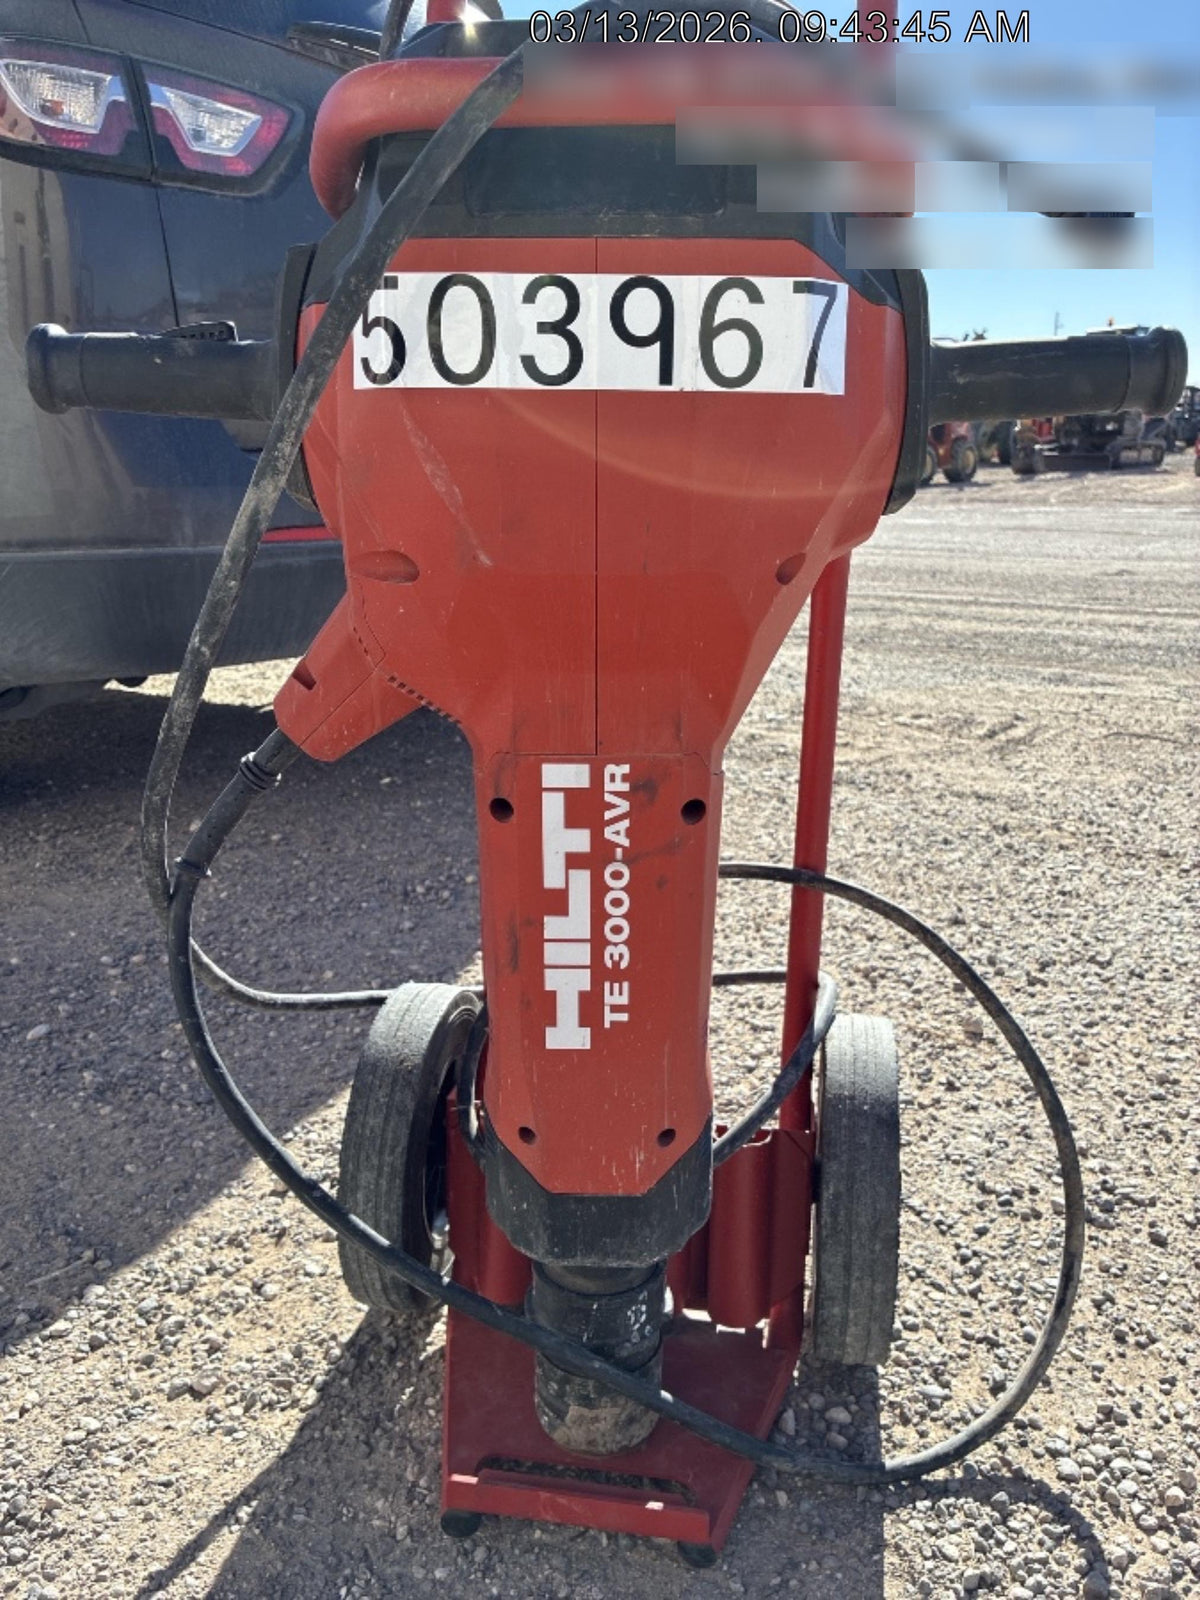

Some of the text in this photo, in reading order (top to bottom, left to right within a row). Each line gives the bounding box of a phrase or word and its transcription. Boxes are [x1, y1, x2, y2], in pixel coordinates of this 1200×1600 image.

[360, 273, 839, 389] 503967
[541, 763, 591, 1050] HILTI
[603, 763, 631, 1029] TE 3000-AVR
